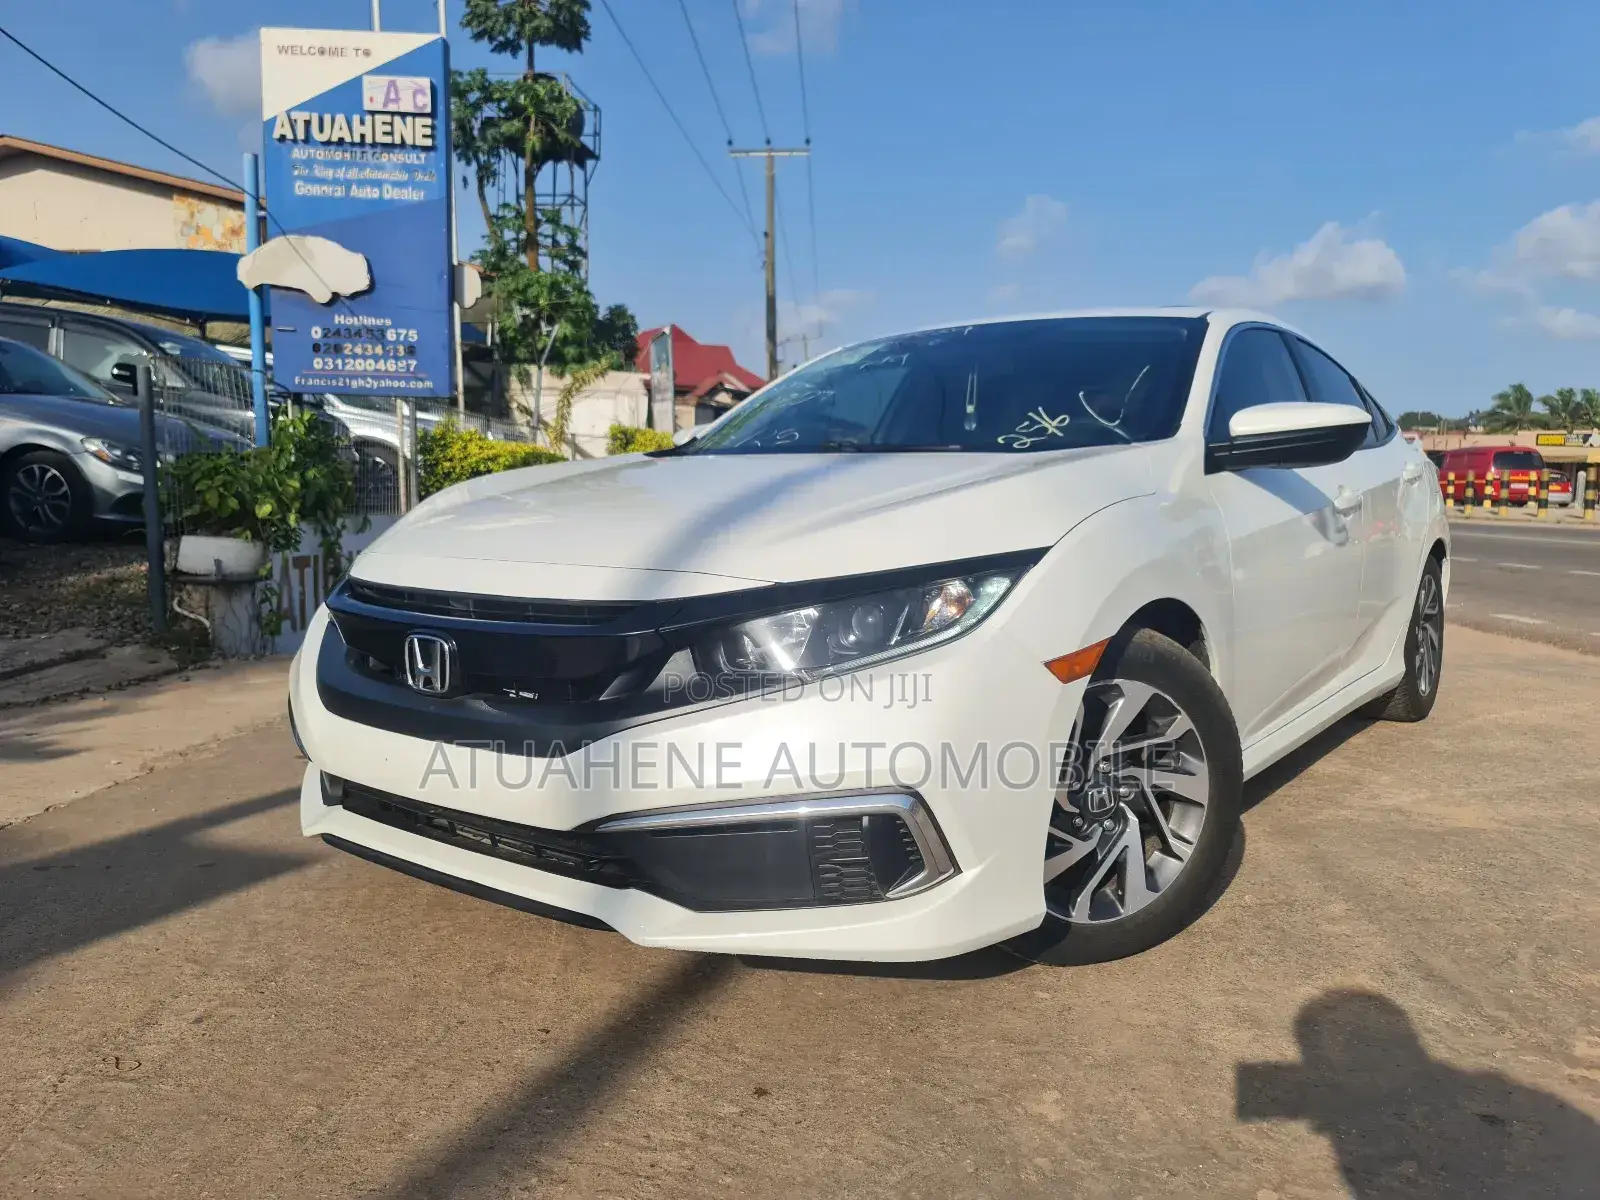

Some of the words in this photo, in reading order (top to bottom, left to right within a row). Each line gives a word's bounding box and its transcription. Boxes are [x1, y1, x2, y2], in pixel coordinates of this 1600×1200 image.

[277, 44, 348, 58] WELCOME
[353, 47, 372, 58] TO
[273, 111, 434, 147] ATUAHENE
[294, 180, 346, 197] General
[350, 182, 380, 199] Auto
[382, 183, 425, 201] Dealer
[334, 313, 393, 327] Hotlines
[313, 357, 418, 372] 0312004687
